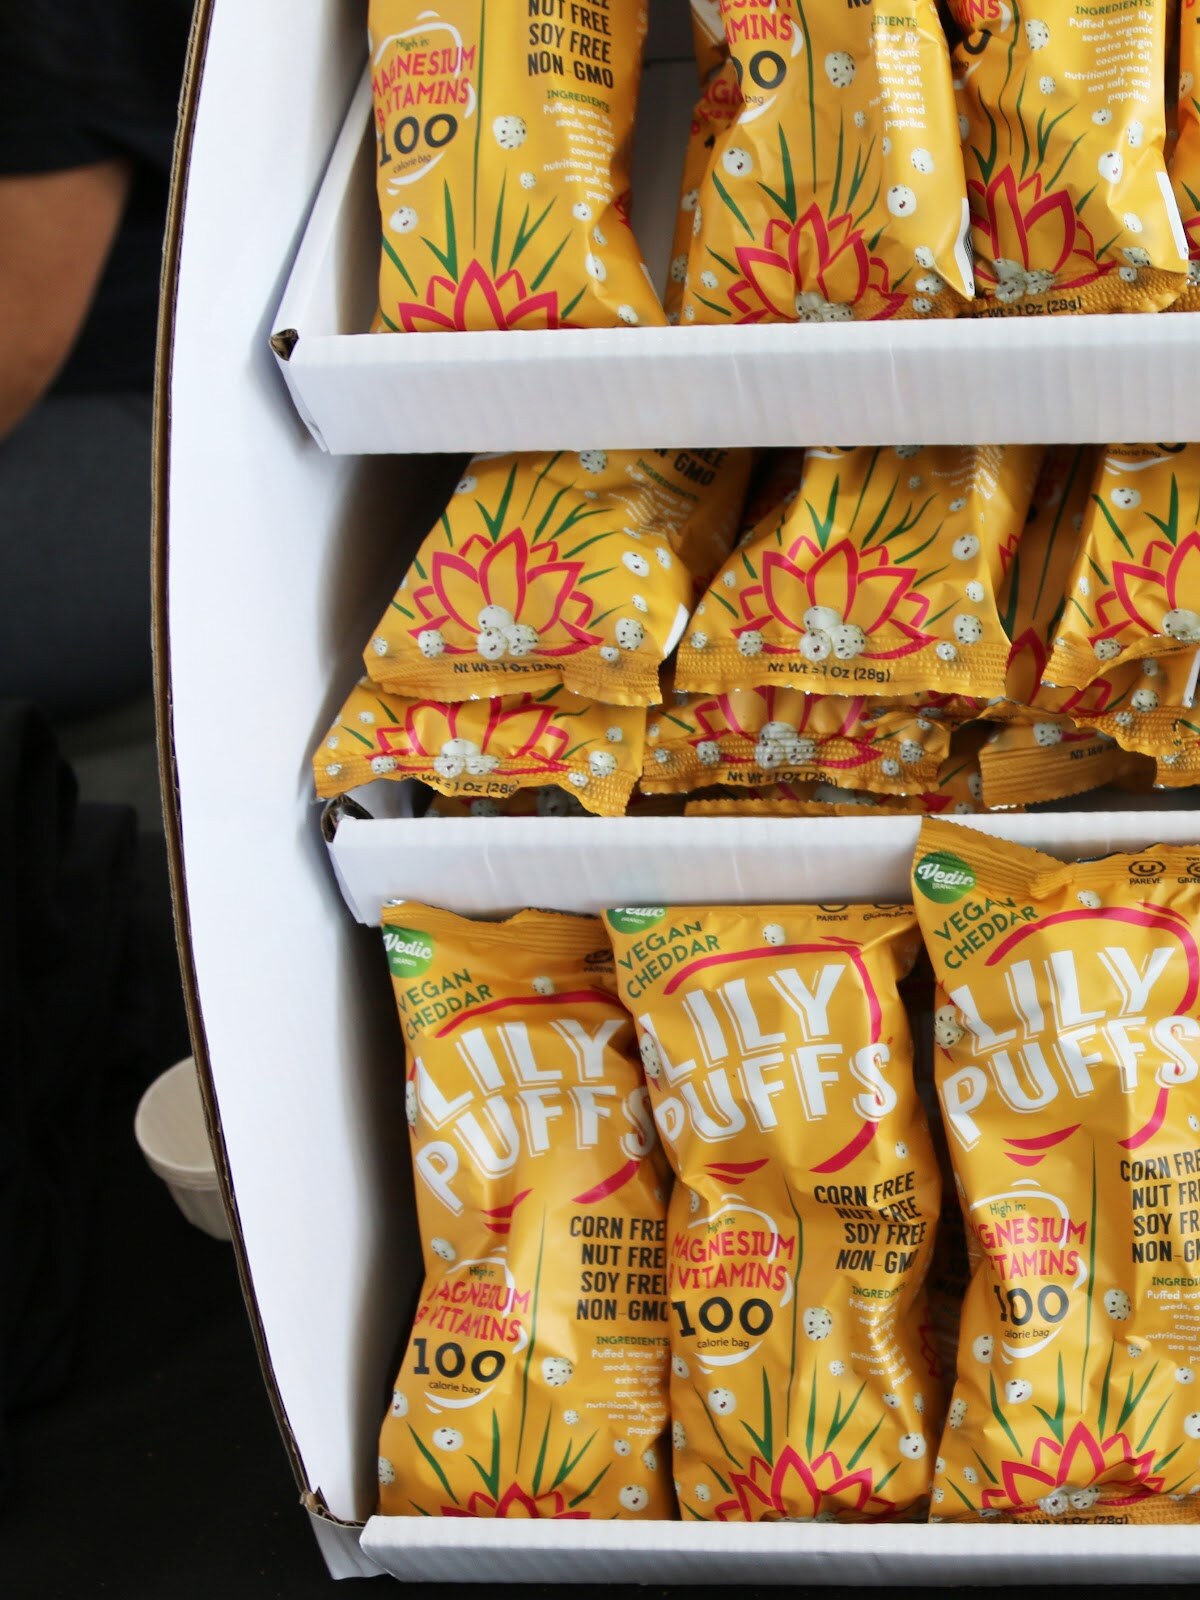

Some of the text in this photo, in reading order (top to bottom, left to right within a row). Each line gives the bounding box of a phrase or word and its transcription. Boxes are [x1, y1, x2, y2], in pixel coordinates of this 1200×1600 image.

[571, 4, 612, 36] FREE
[1069, 17, 1104, 28] Puffed
[529, 23, 612, 64] SOY FREE
[745, 94, 764, 105] bag
[379, 114, 457, 167] 100
[1047, 297, 1082, 313] (28g)
[768, 662, 891, 682] Nt Wt Oz (28g)
[917, 863, 976, 887] Vedic
[1129, 877, 1162, 885] PAREVE
[816, 914, 849, 922] PAREVE
[934, 896, 1018, 942] VEGAN
[383, 933, 432, 961] Vedic
[618, 920, 704, 971] VEGAN
[943, 905, 1039, 970] CHEDDAR
[626, 935, 721, 999] CHEDDAR
[399, 968, 474, 1013] VEGAN
[949, 947, 1177, 1056] LILY
[405, 984, 493, 1041] CHEDDAR
[638, 964, 847, 1089] LILY
[414, 1018, 629, 1130] LILY
[939, 1015, 1200, 1152] PUFFS
[414, 1085, 659, 1216] PUFFS
[1120, 1155, 1172, 1183] CORN
[814, 1171, 915, 1207] CORN FREE
[1131, 1184, 1172, 1211] NUT
[879, 1196, 922, 1223] FREE
[990, 1204, 1008, 1218] High
[570, 1216, 624, 1240] CORN
[845, 1221, 927, 1246] SOY FREE
[1133, 1213, 1172, 1237] SOY
[581, 1244, 622, 1266] NUT
[581, 1272, 620, 1293] SOY
[678, 1262, 788, 1292] VITAMINS
[1146, 1289, 1181, 1301] Puffed
[671, 1296, 774, 1338] 100
[697, 1337, 750, 1350] calorie bag
[1033, 1327, 1050, 1339] bag
[412, 1338, 506, 1382] 100
[429, 1380, 481, 1396] calorie bag
